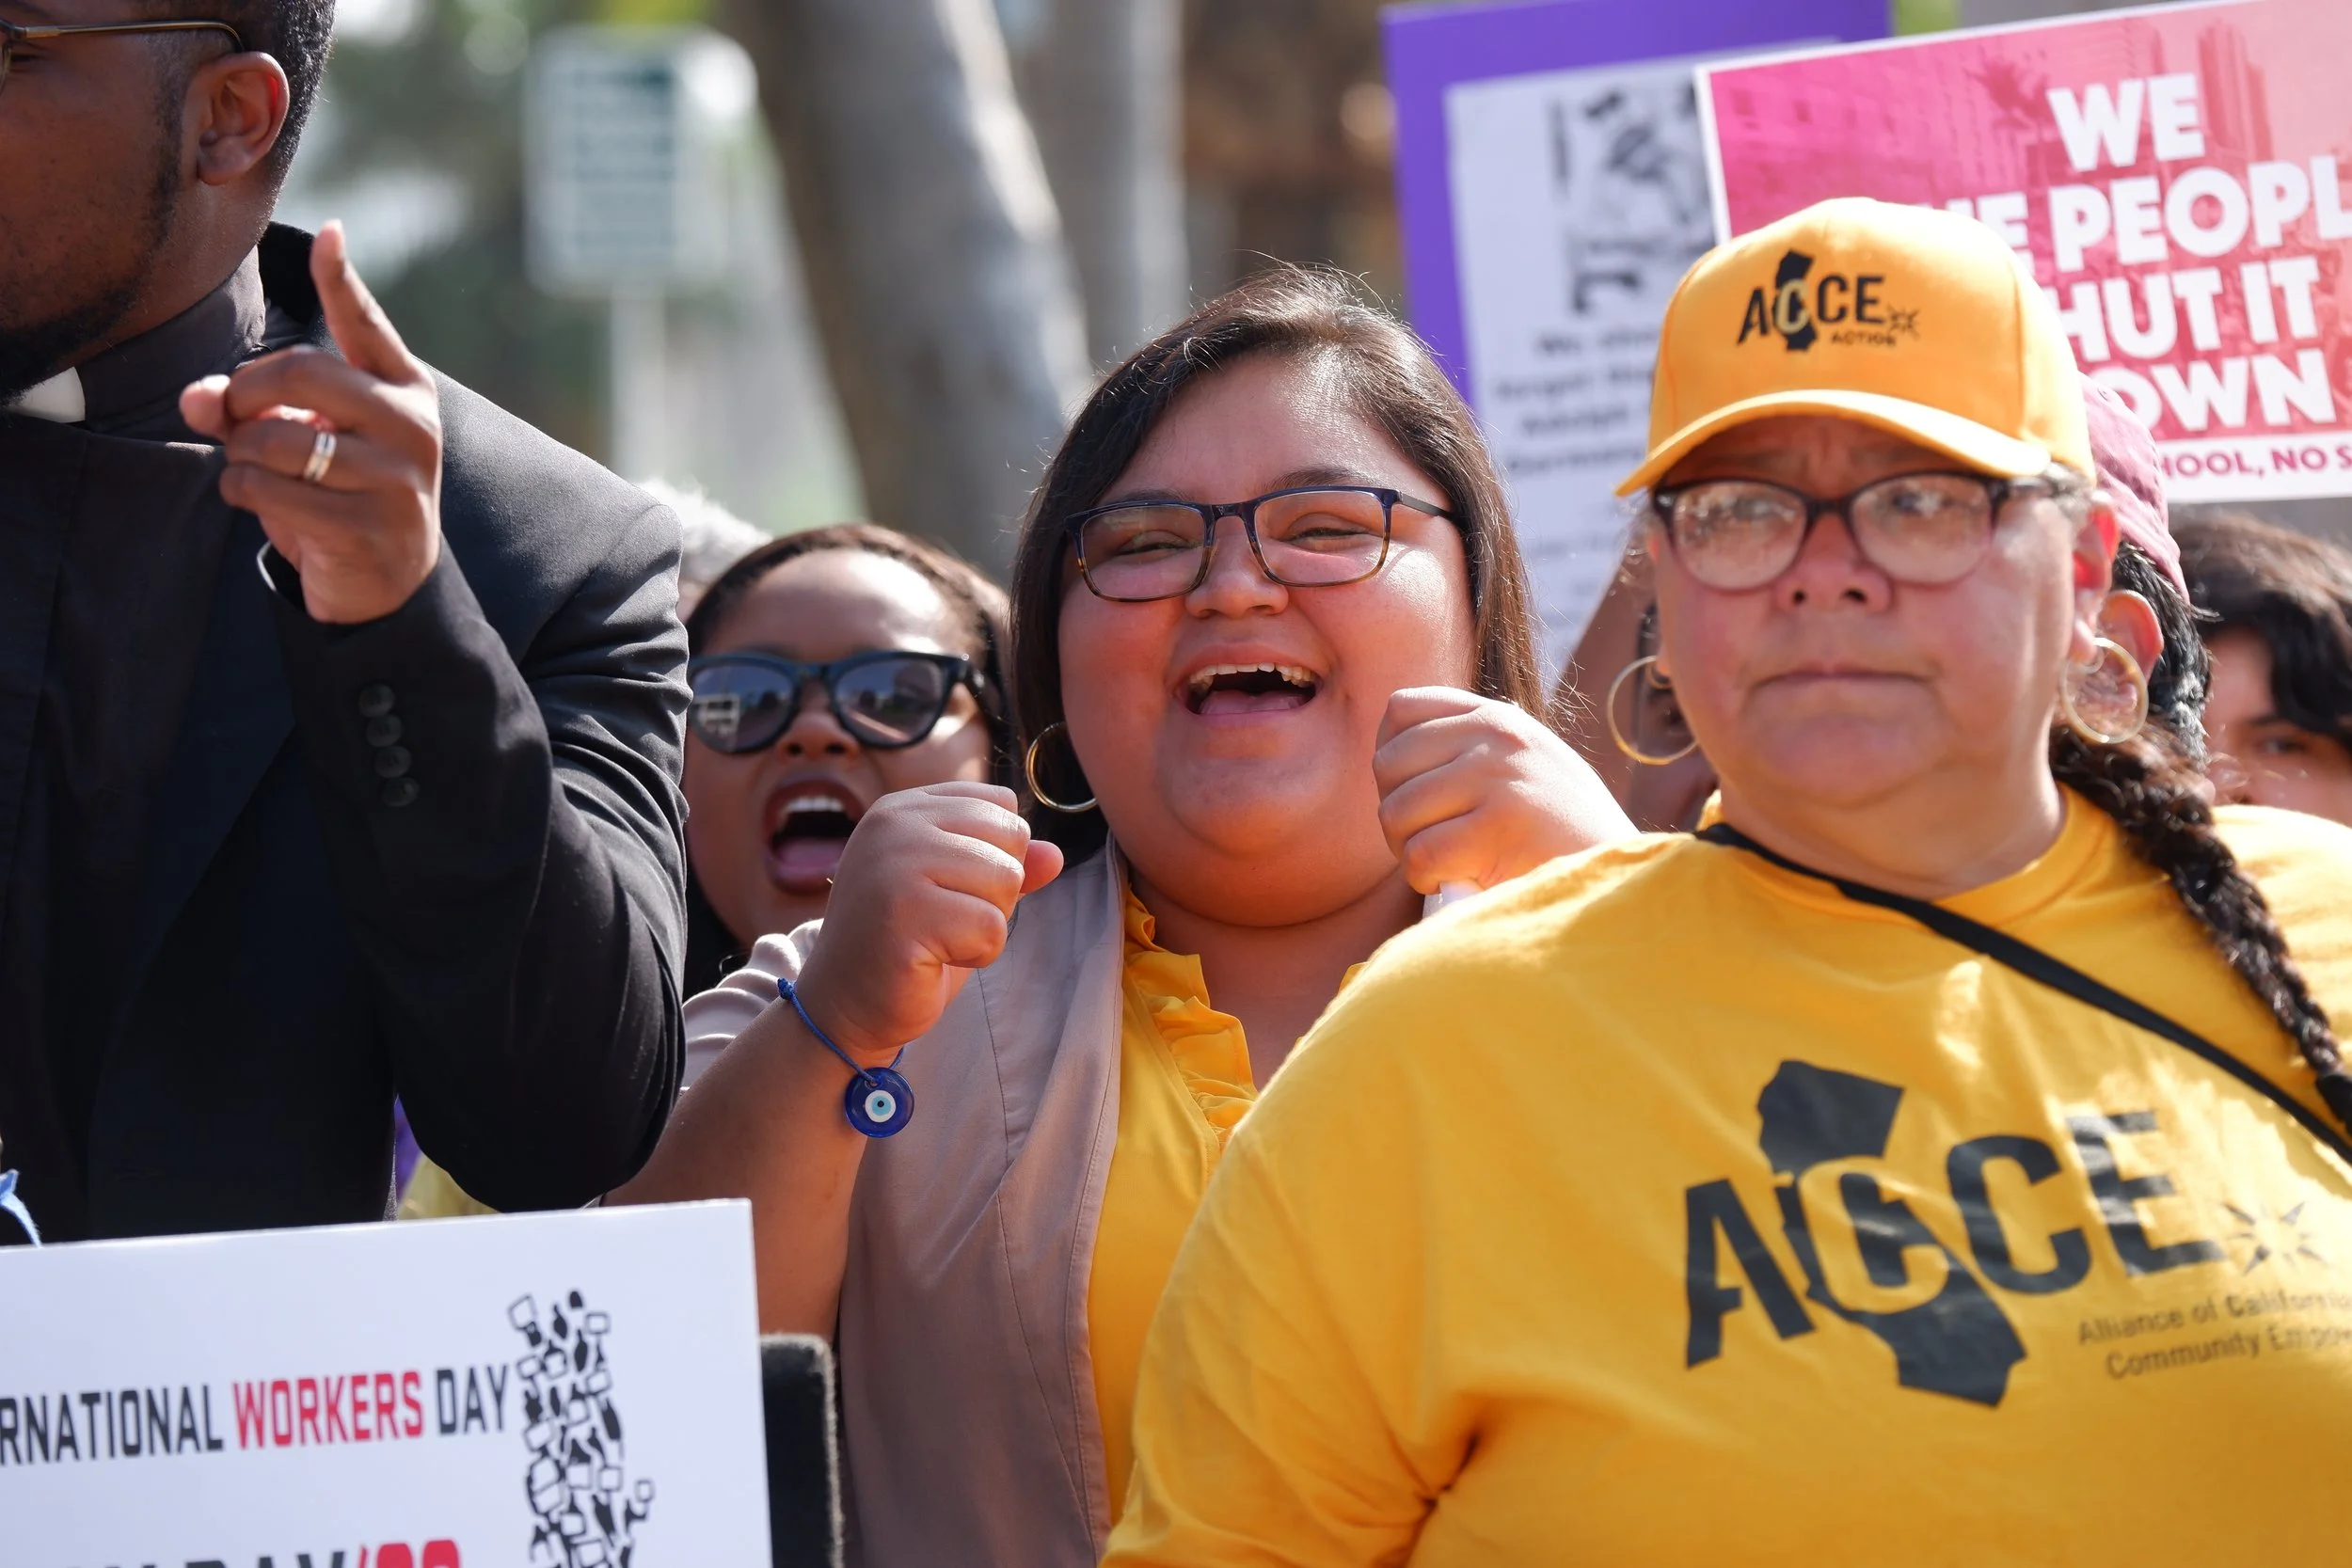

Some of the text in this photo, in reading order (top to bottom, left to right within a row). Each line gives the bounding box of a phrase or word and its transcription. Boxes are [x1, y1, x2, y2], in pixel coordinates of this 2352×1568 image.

[2046, 72, 2206, 172] WE
[2048, 154, 2352, 273] PEOPL
[1737, 274, 1886, 346] ACCE
[1831, 330, 1897, 346] ACTION
[2043, 255, 2321, 363] HUT IT
[2080, 347, 2337, 432] OWN
[2161, 450, 2265, 478] OOL,
[2270, 446, 2328, 471] NO
[1684, 1108, 2226, 1370] ACCE
[2078, 1309, 2185, 1345] Alliance
[2192, 1297, 2219, 1324] of
[2106, 1331, 2260, 1380] Community
[0, 1364, 509, 1466] RNATIONAL WORKERS DAY
